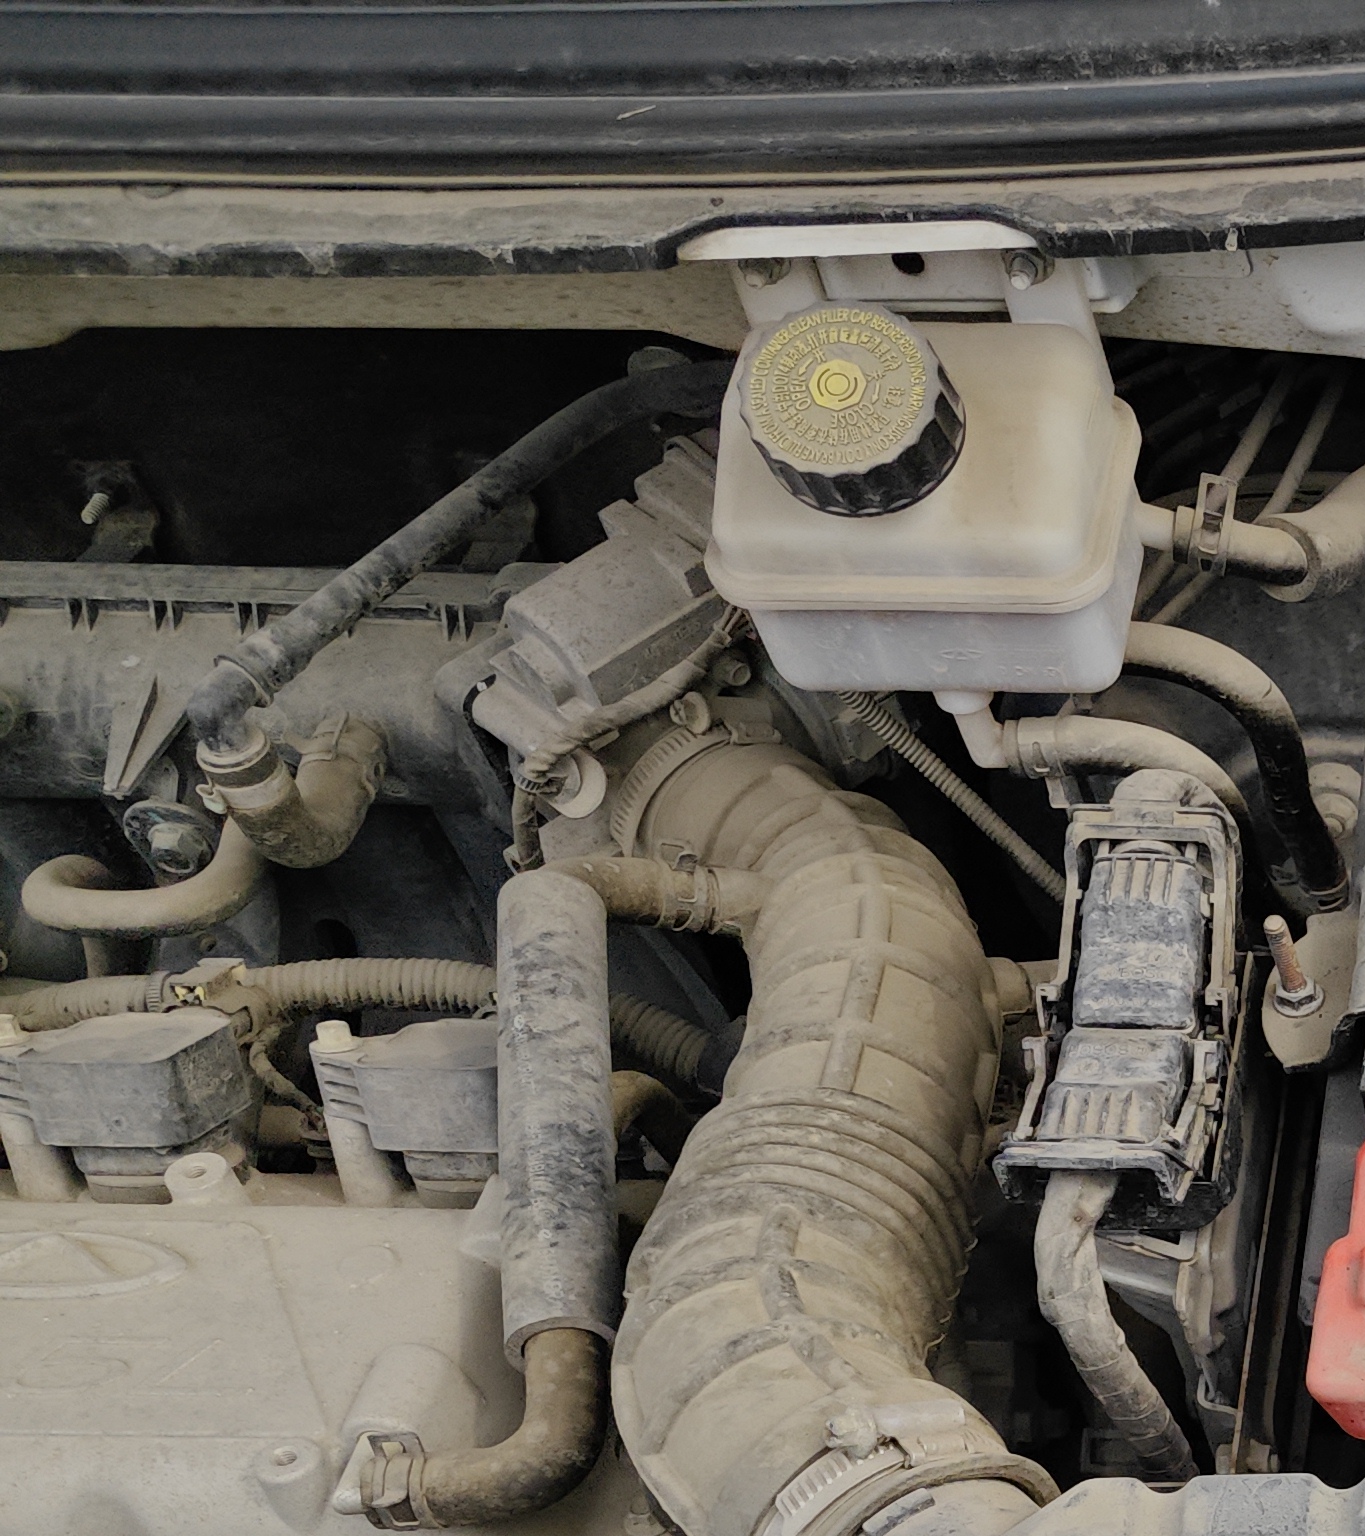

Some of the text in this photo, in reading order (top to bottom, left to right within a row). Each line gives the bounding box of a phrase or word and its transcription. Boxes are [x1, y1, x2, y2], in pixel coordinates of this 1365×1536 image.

[850, 309, 870, 326] CAP
[788, 374, 812, 413] OPEN
[828, 400, 877, 427] CLOSE
